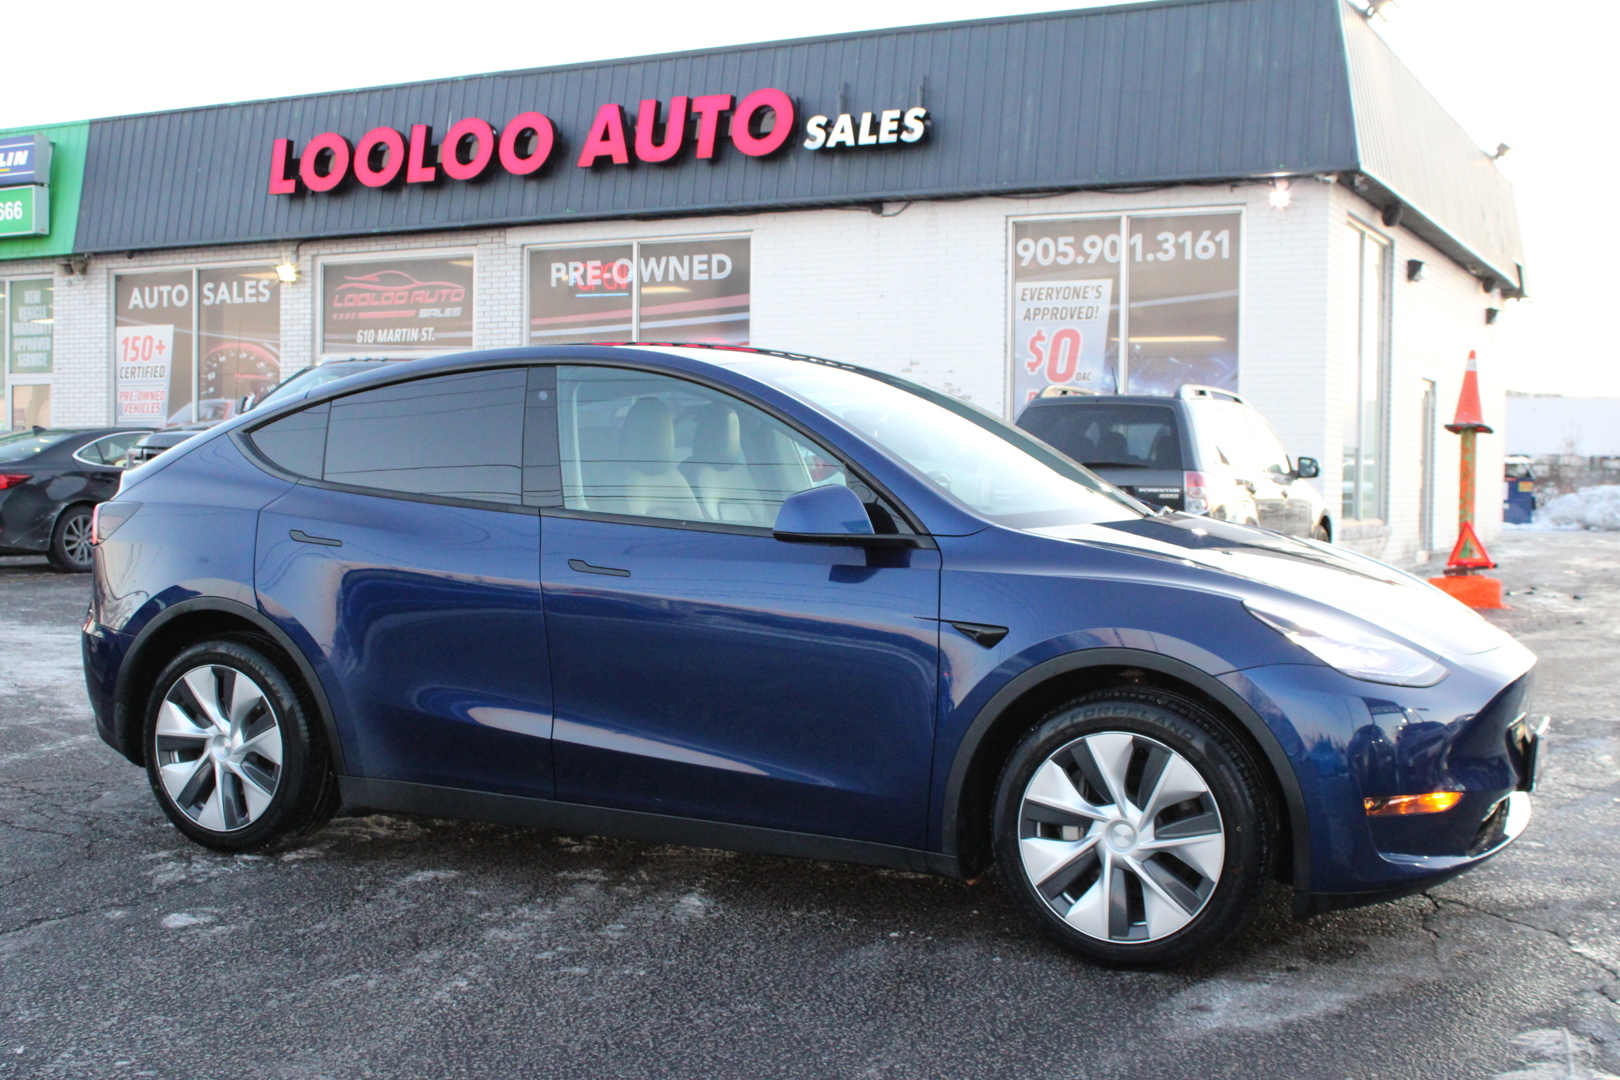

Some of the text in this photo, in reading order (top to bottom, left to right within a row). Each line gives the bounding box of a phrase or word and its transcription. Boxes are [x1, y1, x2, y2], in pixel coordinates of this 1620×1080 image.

[269, 87, 927, 195] LOOLOO AUTO SALES
[1016, 229, 1230, 267] 905.901.3161
[550, 253, 733, 288] PRE-OWNED
[128, 279, 271, 309] AUTO SALES
[332, 288, 466, 308] LOOLOO AUTO
[1020, 285, 1103, 302] EVERYONE'S
[418, 307, 463, 319] SALES
[1022, 305, 1100, 322] APPROVED!
[356, 327, 435, 344] 610 MARTIN ST.
[121, 335, 166, 362] 150+
[1026, 328, 1081, 383] $0
[119, 365, 165, 380] CERTIFIED
[118, 390, 165, 402] PRE-OWNED
[123, 402, 161, 414] VEHICLES
